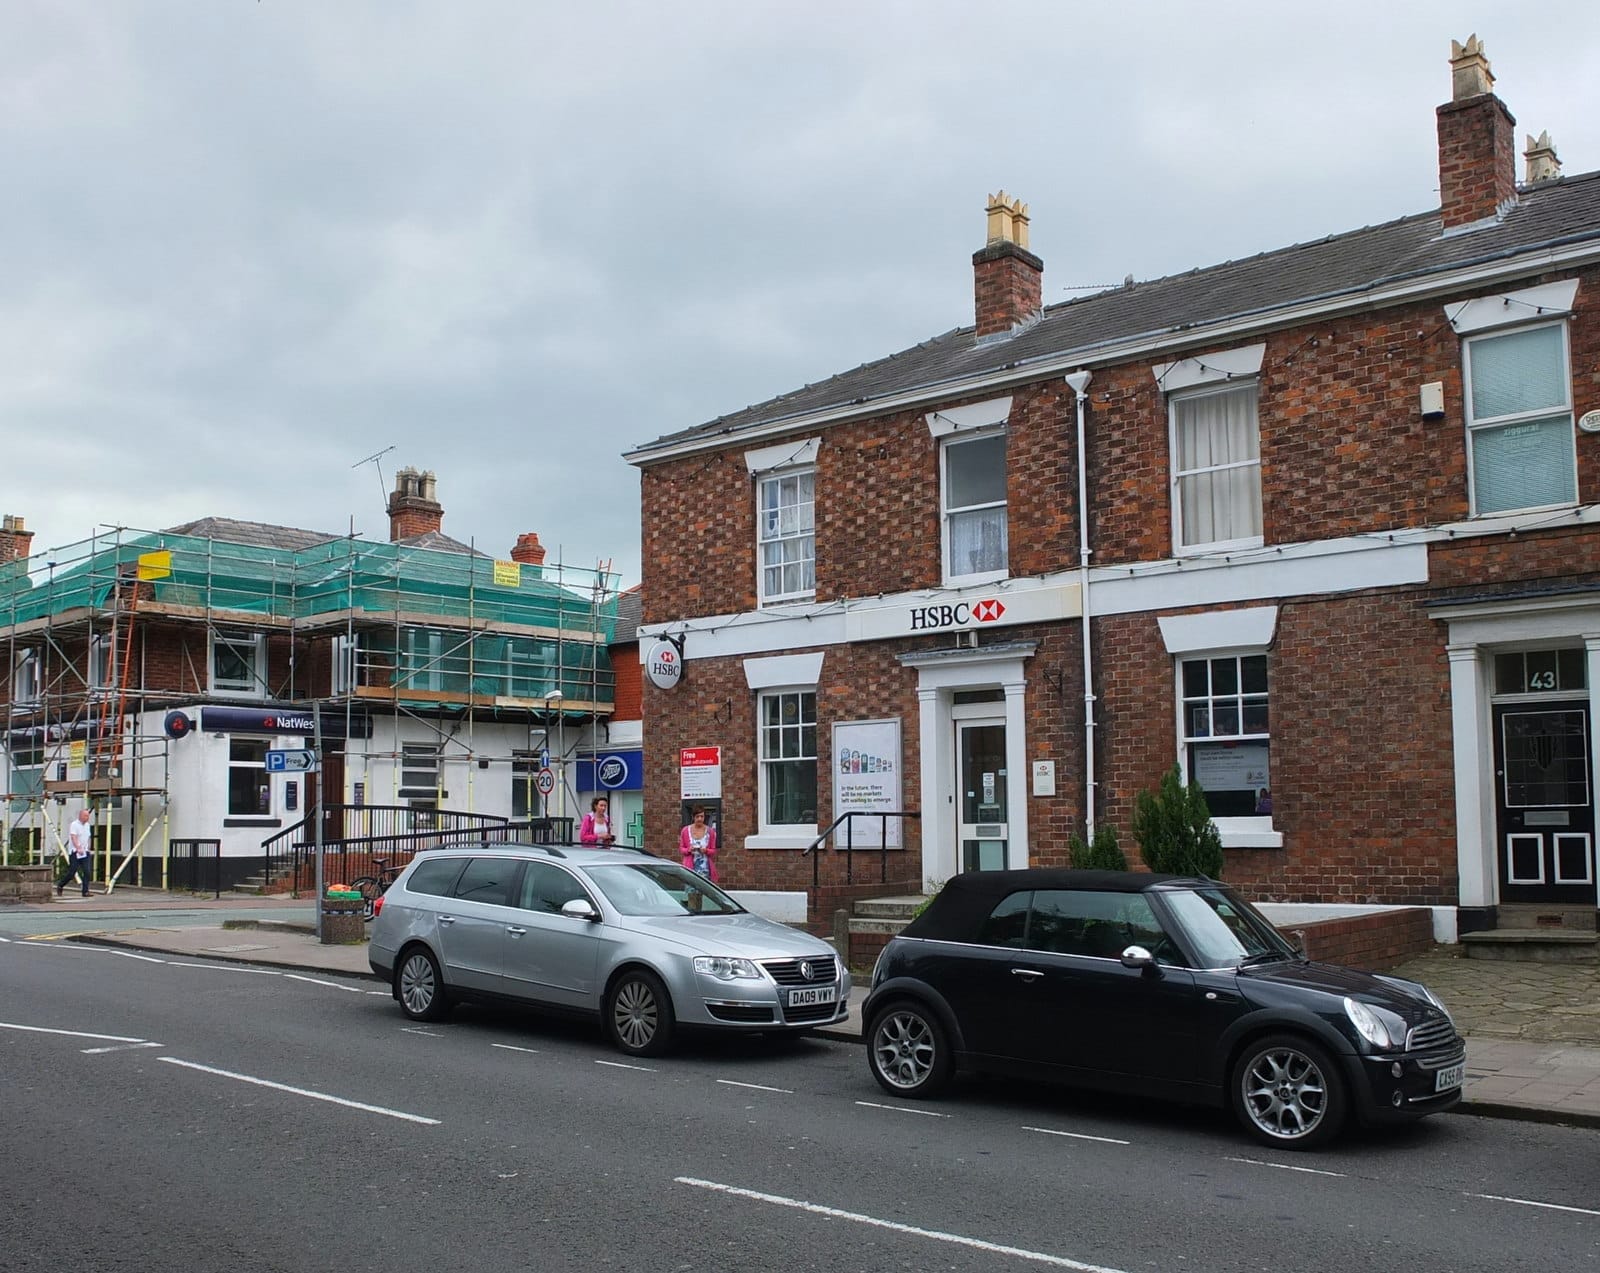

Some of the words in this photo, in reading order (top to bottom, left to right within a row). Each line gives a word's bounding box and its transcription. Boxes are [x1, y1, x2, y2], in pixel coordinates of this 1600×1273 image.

[910, 603, 970, 630] HSBC
[653, 663, 680, 677] HSBC
[1530, 671, 1555, 689] 43
[277, 717, 315, 729] NatWes
[271, 755, 283, 769] P
[683, 751, 696, 759] Free
[602, 763, 620, 779] Boots
[540, 776, 551, 786] 20
[793, 991, 815, 1004] DA09
[1439, 1068, 1455, 1088] CX55
